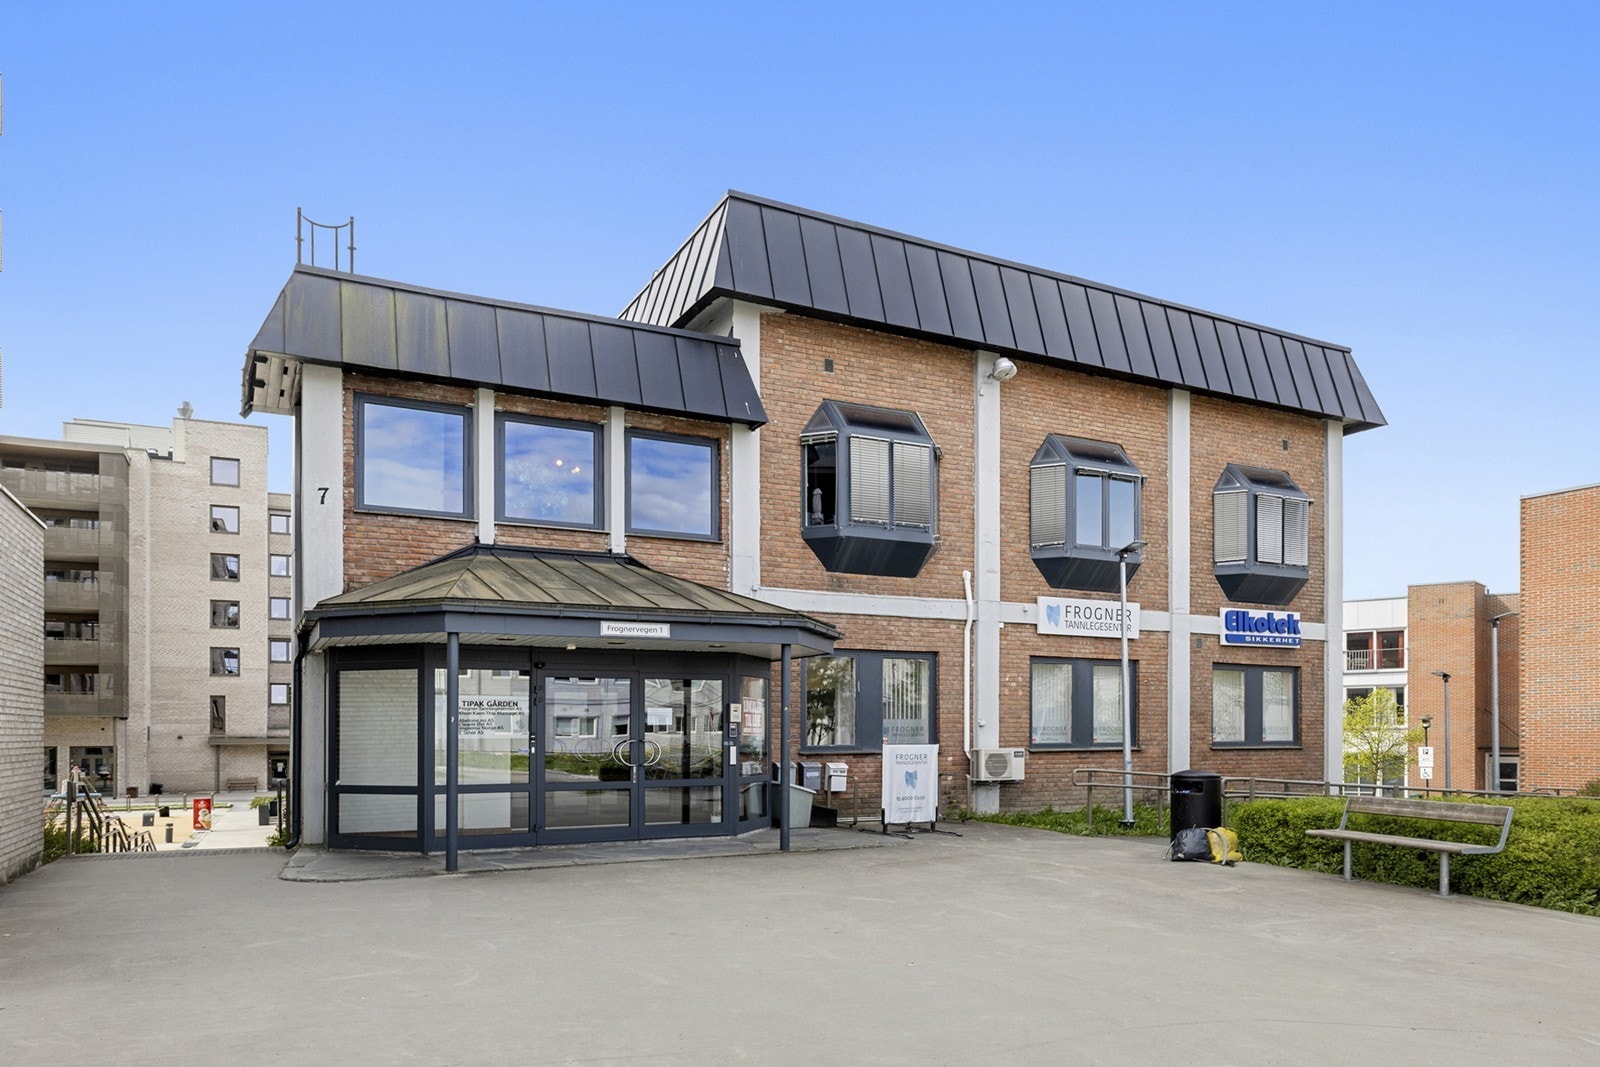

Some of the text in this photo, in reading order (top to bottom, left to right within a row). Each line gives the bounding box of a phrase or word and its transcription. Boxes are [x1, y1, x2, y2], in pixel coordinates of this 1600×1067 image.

[317, 487, 330, 505] 7
[1064, 605, 1132, 622] FROGNER
[1064, 620, 1132, 632] TANNLEGESENTR
[1225, 610, 1301, 635] Elkotek
[607, 625, 658, 634] Frognervegen
[1245, 636, 1300, 644] SIKKERHET
[487, 699, 519, 707] GÅRDEN
[895, 753, 928, 761] FROGNER
